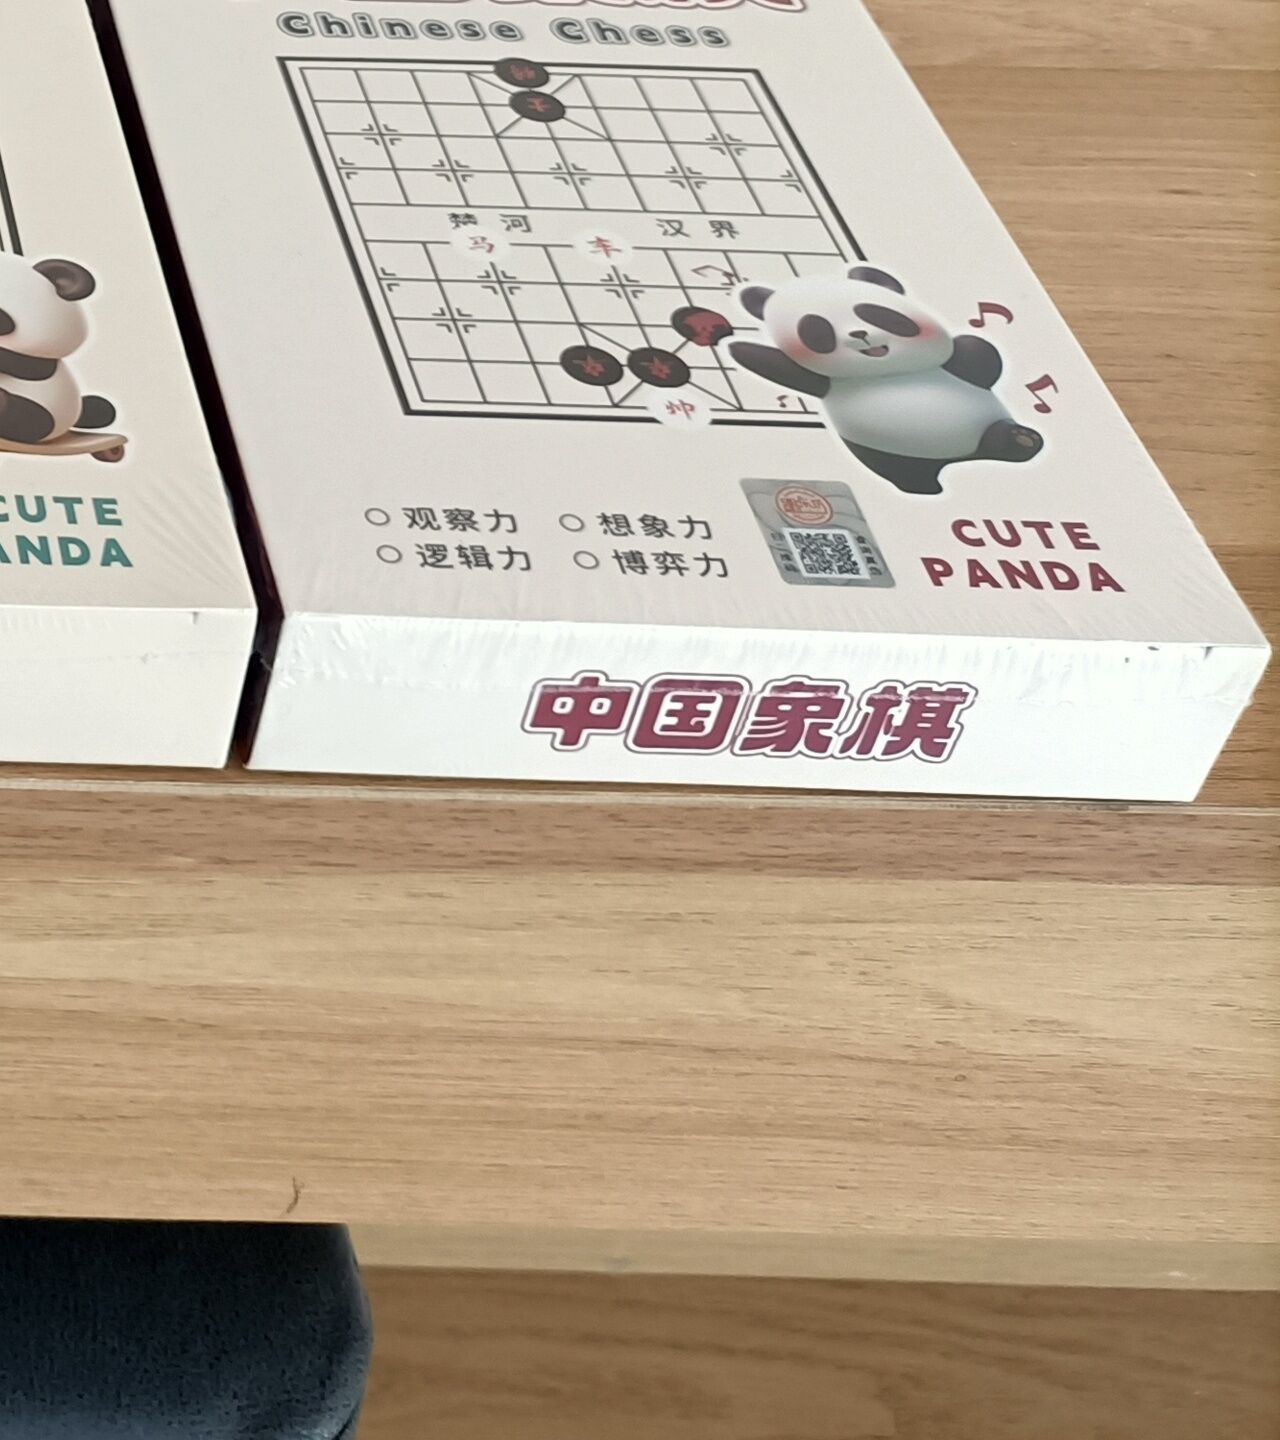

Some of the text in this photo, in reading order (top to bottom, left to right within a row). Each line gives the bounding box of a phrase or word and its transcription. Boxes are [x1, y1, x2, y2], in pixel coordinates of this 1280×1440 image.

[276, 12, 733, 48] Chinese Chess
[469, 235, 494, 254] 马
[587, 236, 621, 257] 车
[403, 505, 713, 540] 观察力 想象力
[951, 518, 1100, 550] CUTE
[416, 543, 730, 579] 逻辑力 博弈力
[920, 557, 1126, 592] PANDA
[522, 670, 977, 763] 中国象棋
